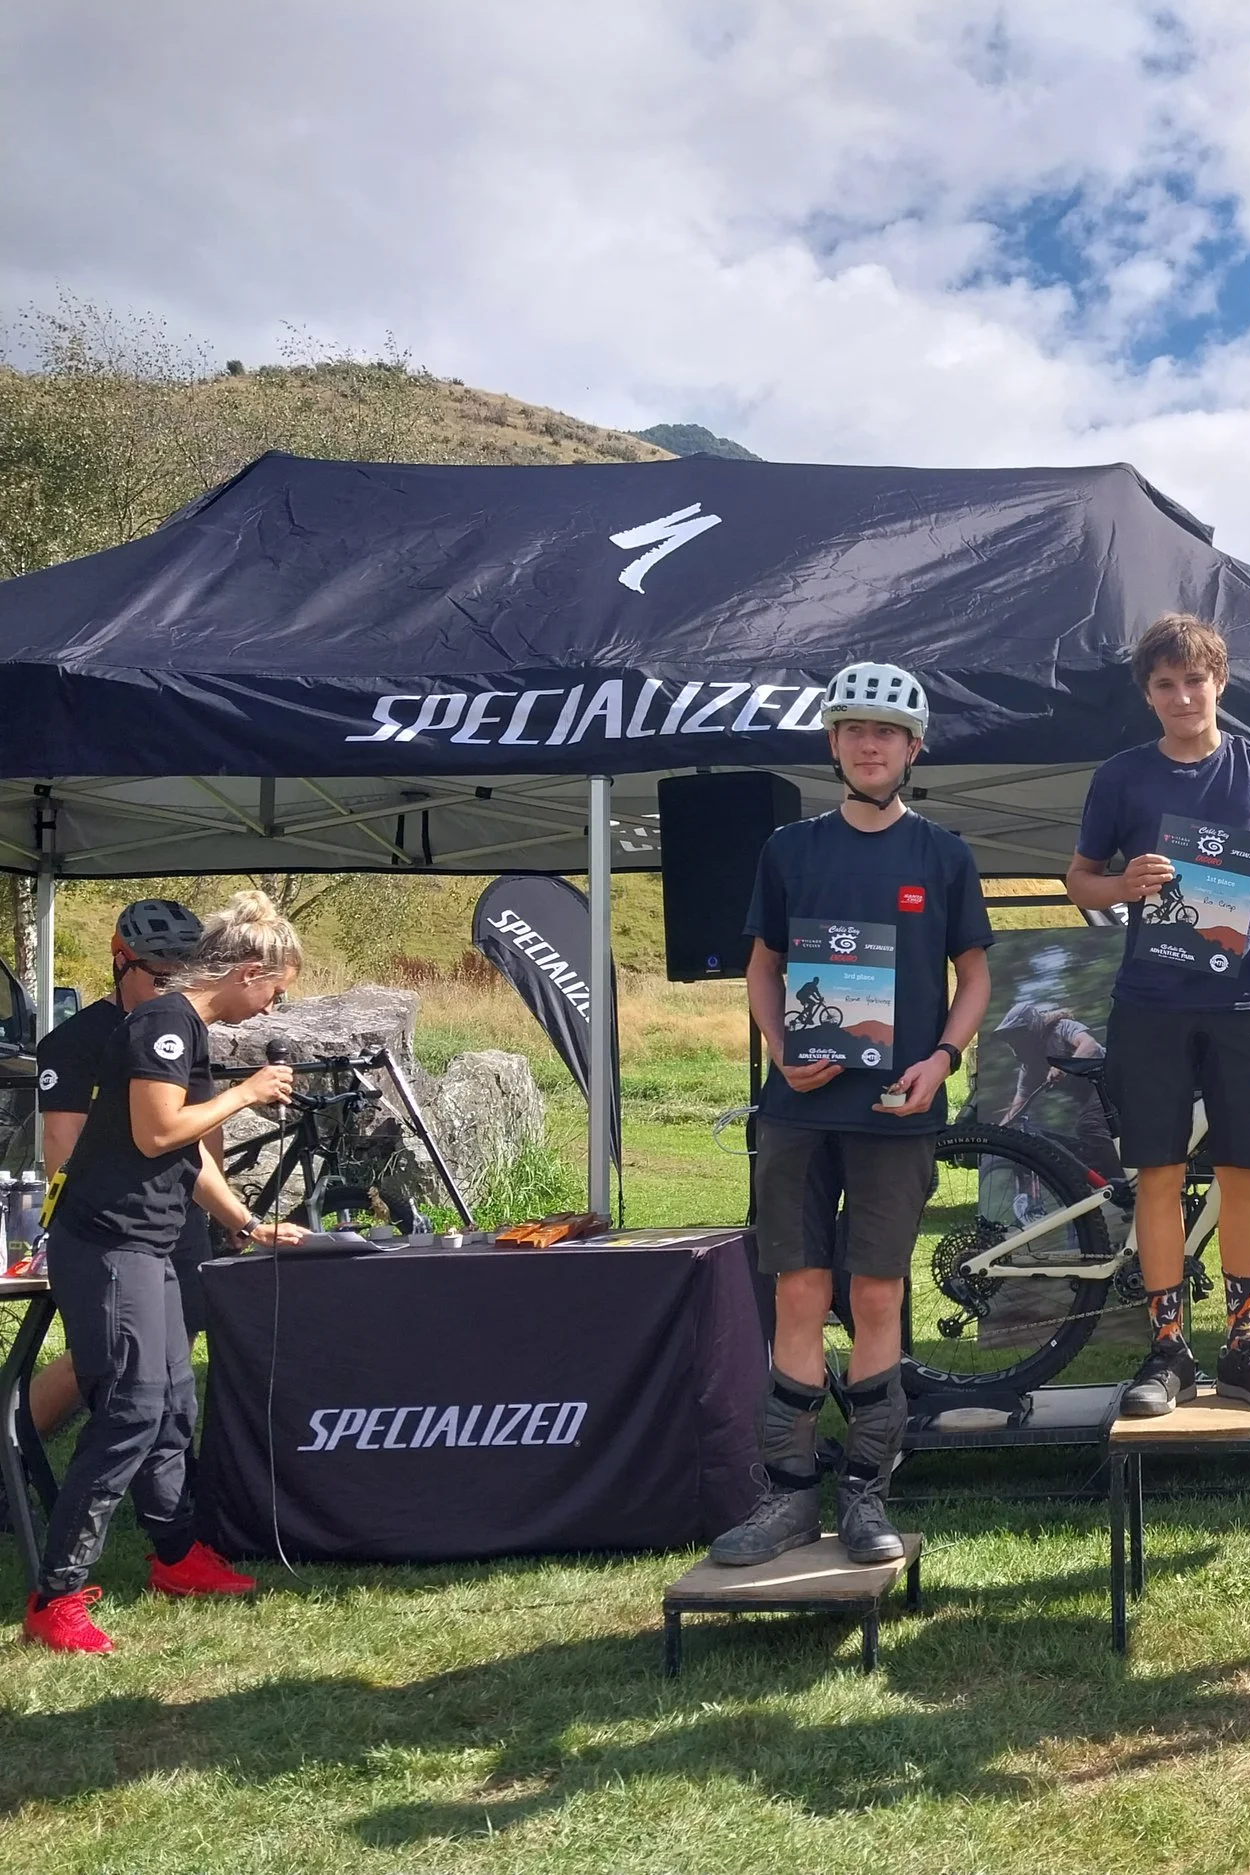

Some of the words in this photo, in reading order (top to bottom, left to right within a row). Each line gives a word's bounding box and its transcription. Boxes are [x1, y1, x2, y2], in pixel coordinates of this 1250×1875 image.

[344, 679, 824, 746] SPECIALIZED
[1217, 830, 1230, 839] Bay
[1206, 875, 1217, 883] 1st
[1217, 878, 1236, 887] place
[847, 926, 861, 935] Bay
[487, 910, 590, 1023] SPECIALIZ
[843, 972, 856, 980] 3rd
[856, 973, 875, 981] place
[937, 1136, 989, 1147] LIMINATOR
[297, 1402, 588, 1451] SPECIALIZED
